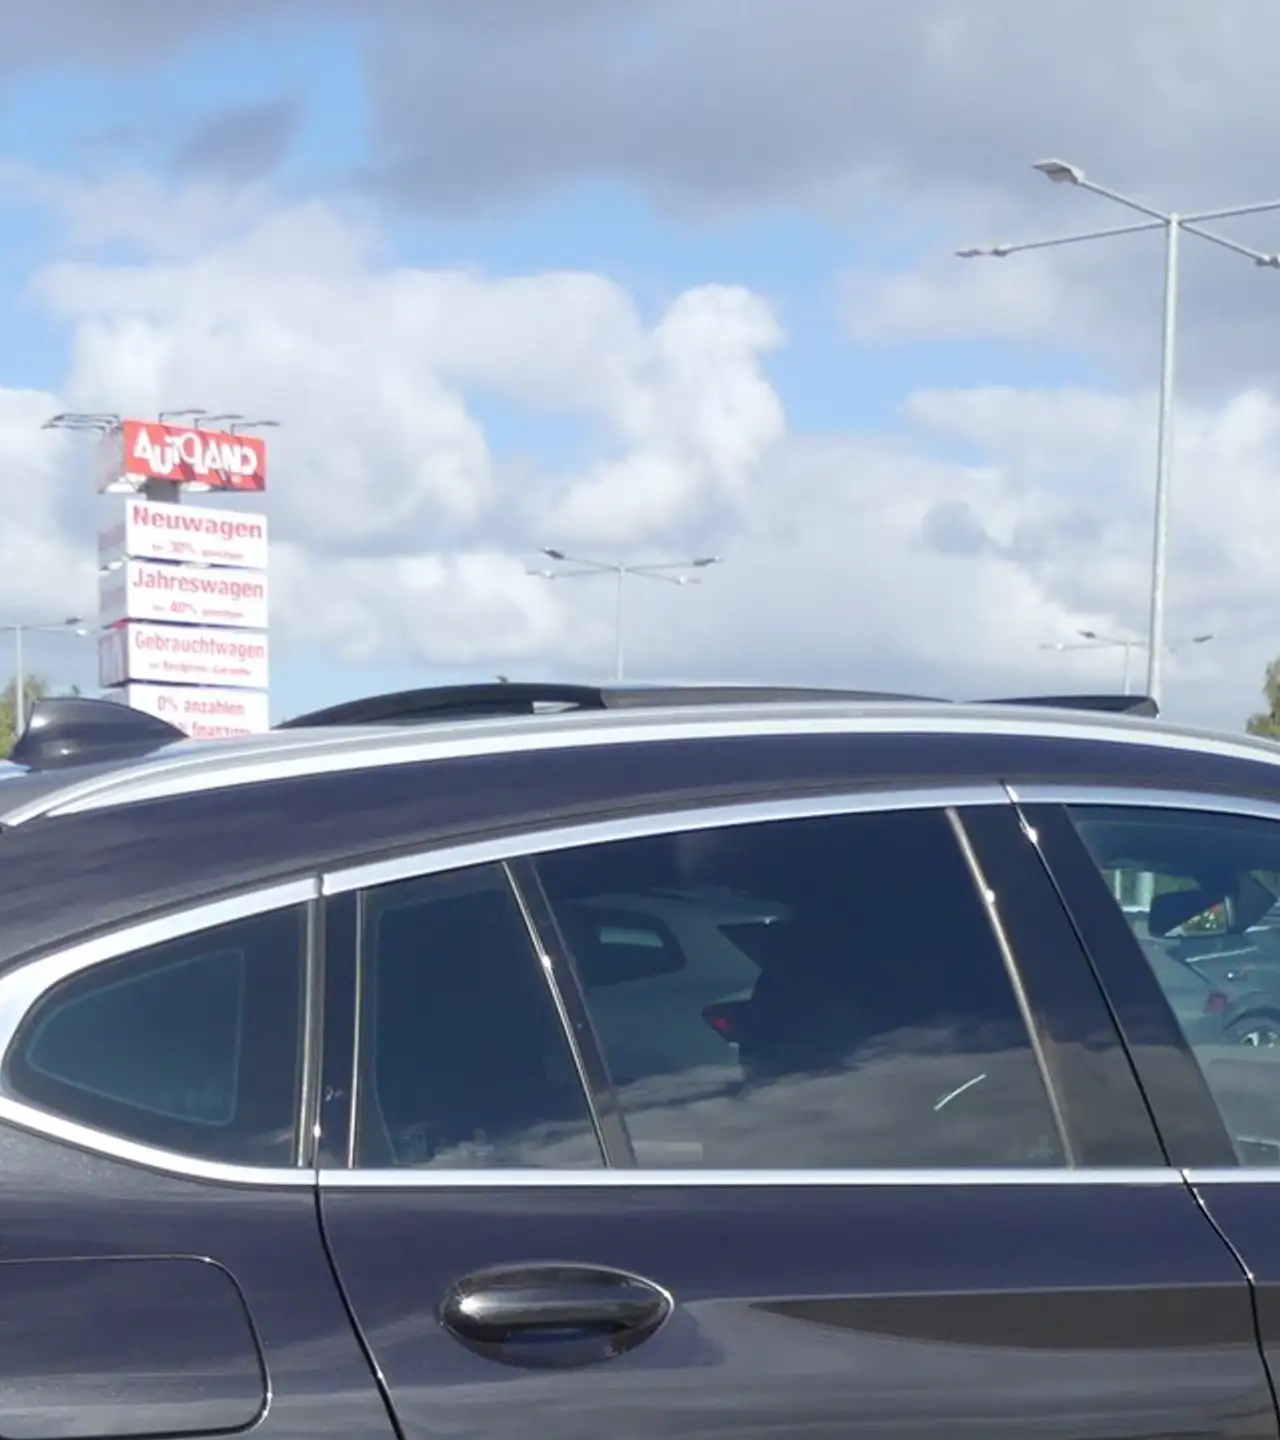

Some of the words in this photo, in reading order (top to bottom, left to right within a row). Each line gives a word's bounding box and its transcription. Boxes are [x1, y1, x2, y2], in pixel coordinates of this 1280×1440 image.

[133, 428, 258, 477] AUTOLAND
[133, 505, 262, 541] Neuwagen
[133, 568, 263, 601] Jahreswagen
[135, 630, 265, 661] Gebrauchtwagen
